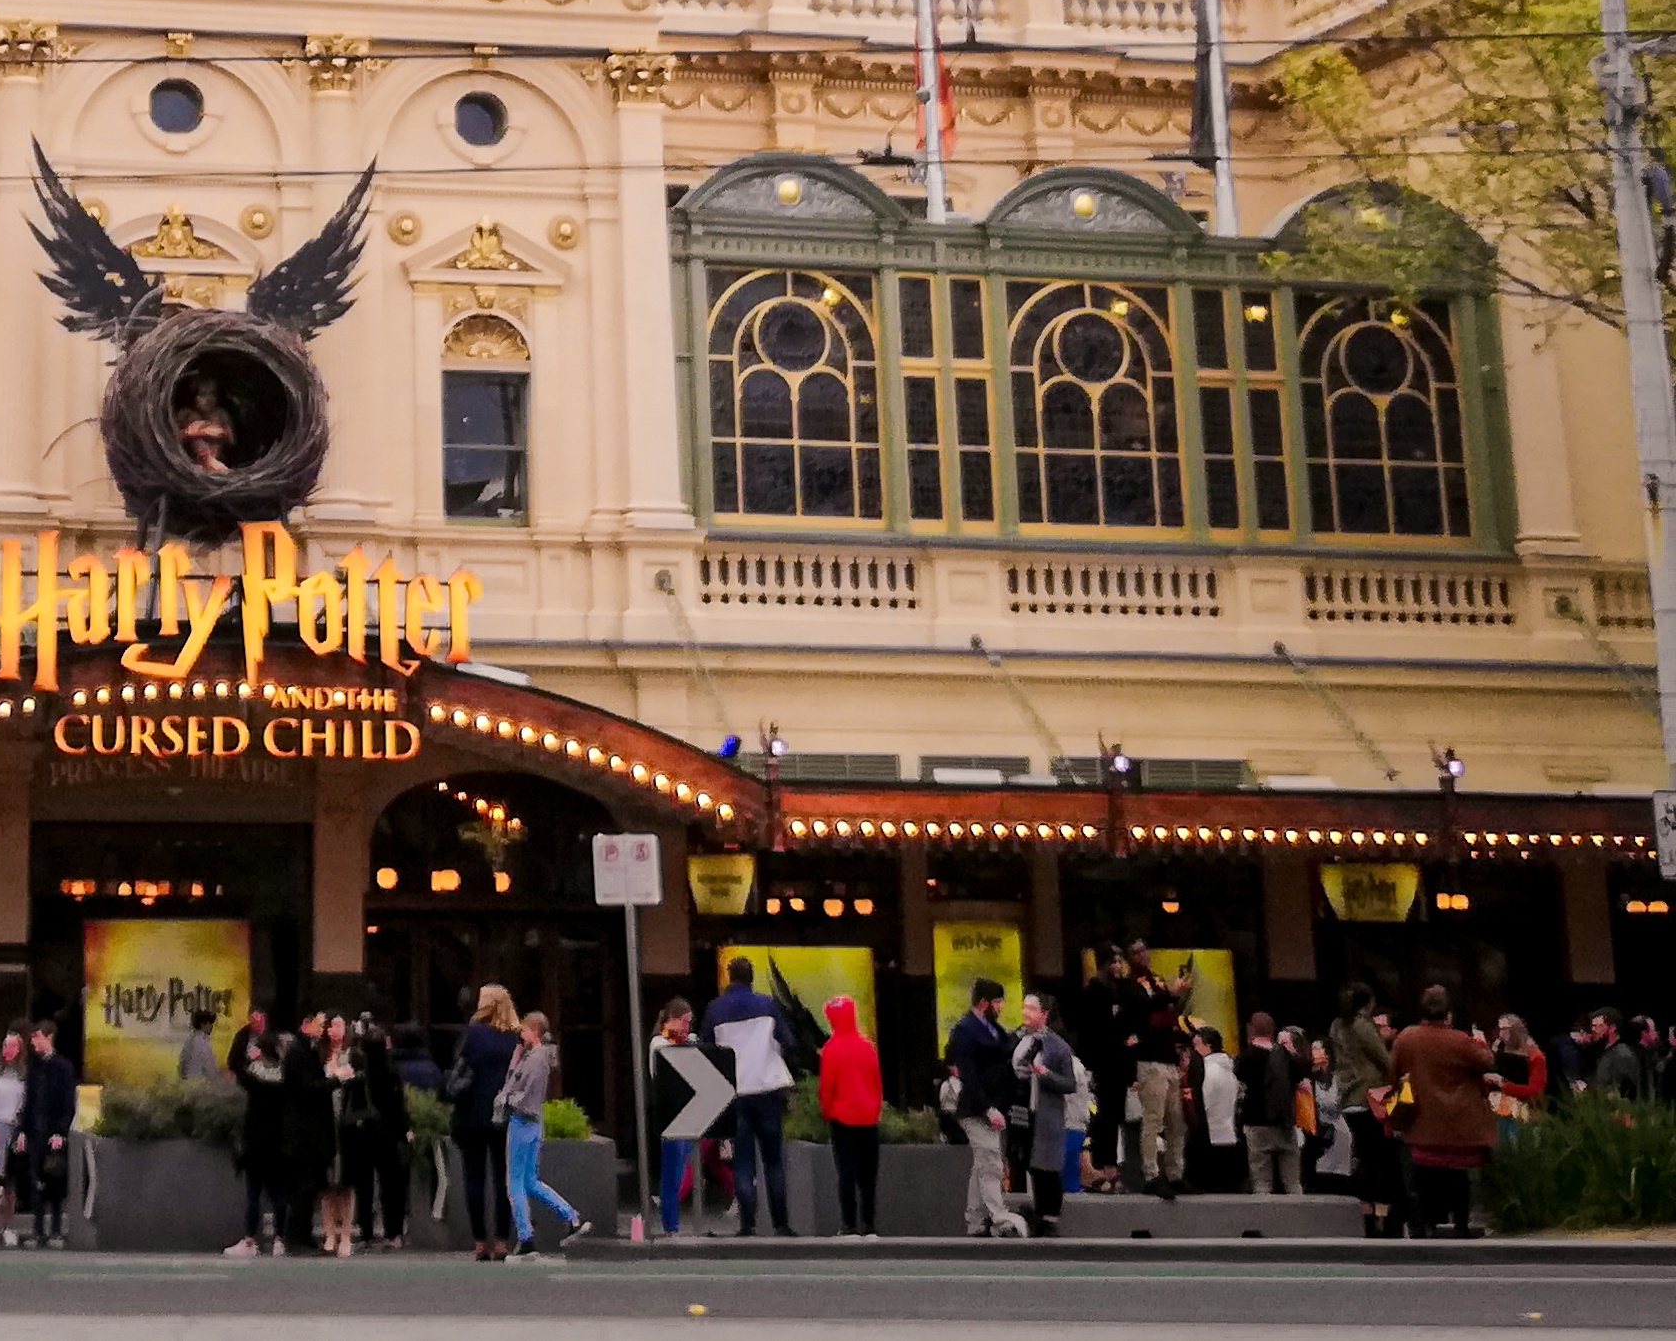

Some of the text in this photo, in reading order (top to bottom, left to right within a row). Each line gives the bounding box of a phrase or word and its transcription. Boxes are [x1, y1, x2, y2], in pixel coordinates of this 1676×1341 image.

[238, 521, 484, 687] Potter
[271, 686, 398, 712] AND THE
[54, 714, 421, 759] CURSED CHILD
